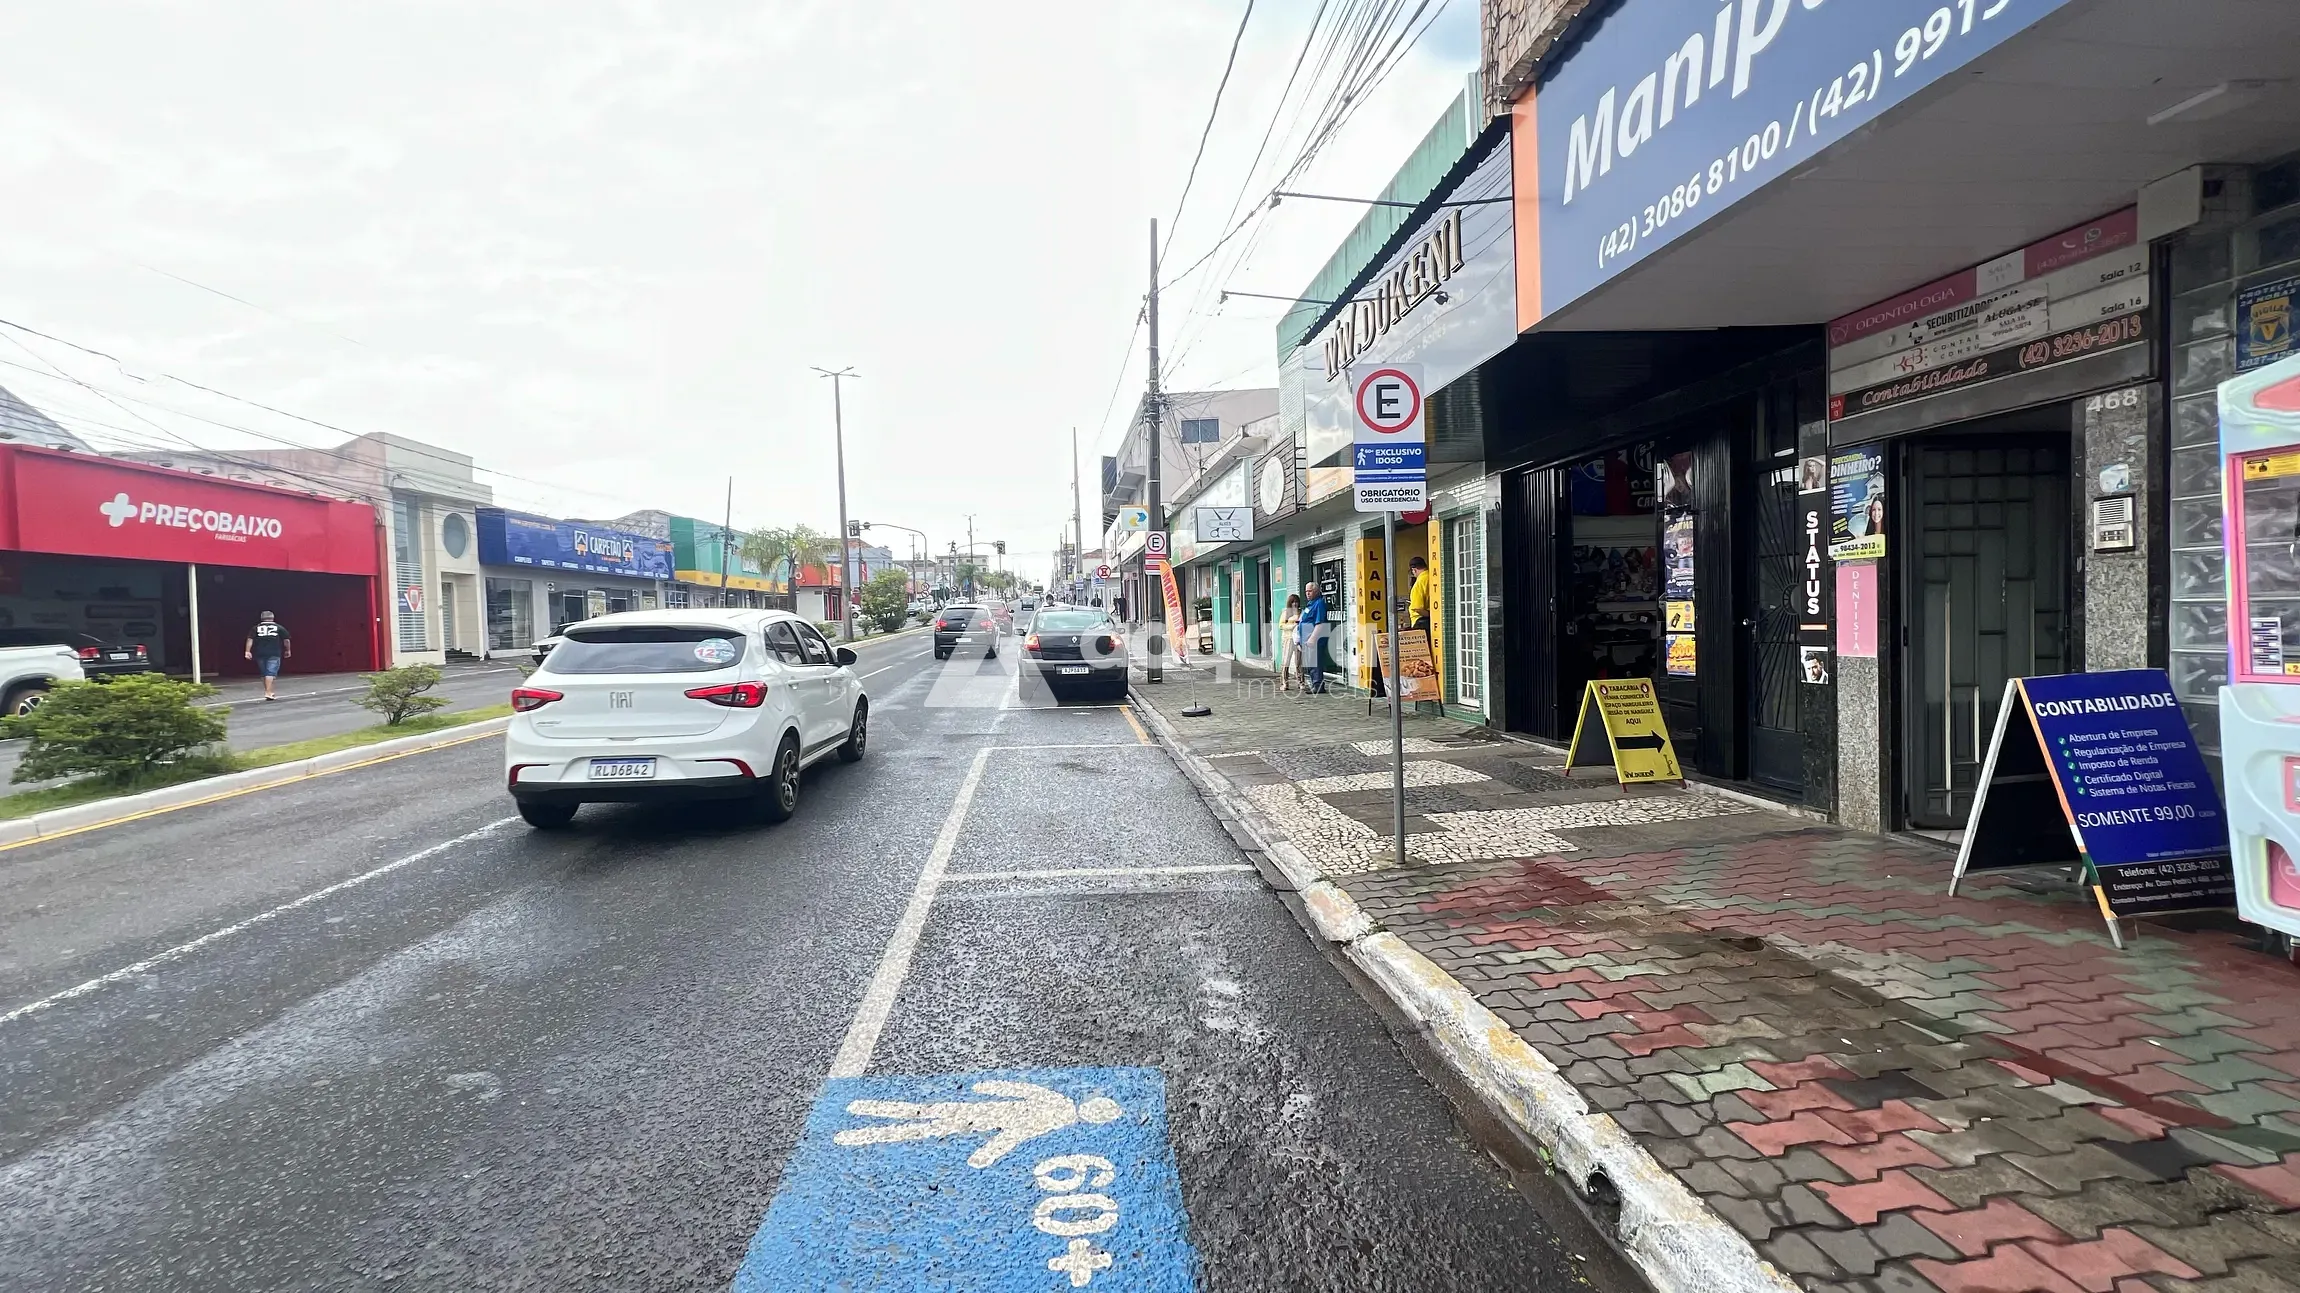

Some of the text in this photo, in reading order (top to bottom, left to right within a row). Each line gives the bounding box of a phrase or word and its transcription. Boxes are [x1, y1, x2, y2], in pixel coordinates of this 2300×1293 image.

[1563, 0, 1823, 206] Manip
[1598, 215, 1637, 268] (42)
[1641, 172, 1701, 237] 3086
[1706, 120, 1780, 194] 8100
[1808, 49, 1882, 135] (42)
[2100, 262, 2142, 283] Sala 12
[1855, 287, 1955, 331] ODONTOLOGIA
[2101, 296, 2142, 315] Sala 16
[1862, 315, 2142, 406] Contabilidade (42) 3236-2013
[1376, 384, 1400, 419] E
[2086, 388, 2138, 412] 468
[1375, 448, 1422, 457] EXCLUSIVO
[1375, 457, 1403, 465] IDOSO
[1830, 455, 1882, 479] DINHEIRO?
[1360, 488, 1420, 497] OBRIGATÓRIO
[139, 501, 283, 539] PREÇOBAIXO
[589, 536, 622, 558] CARPETÃO
[1151, 537, 1160, 548] E
[1840, 542, 1876, 552] 98434-2013
[1805, 510, 1821, 616] STATUS
[1852, 570, 1860, 651] DENTISTA
[256, 624, 278, 637] 92
[610, 691, 634, 708] FIAT
[2035, 692, 2177, 717] CONTABILIDADE
[1626, 717, 1642, 726] AQUI
[2069, 727, 2159, 743] Abertura de Empresa
[2073, 740, 2187, 759] Regularização de Empresa
[594, 763, 649, 777] RLD6B42
[2079, 756, 2159, 772] Imposto de Renda
[2084, 770, 2163, 785] Certificado Digital
[2089, 780, 2197, 797] Sistema de Notas Fiscais
[2078, 807, 2153, 828] SOMENTE
[2154, 804, 2196, 822] 99,00
[2118, 859, 2221, 878] Telefone: (42) 3236-2013
[2112, 881, 2145, 892] Endereço:
[2145, 879, 2154, 888] Av.
[2155, 879, 2173, 887] Dom
[2172, 877, 2192, 885] Pedro
[1033, 1153, 1118, 1288] 60+
